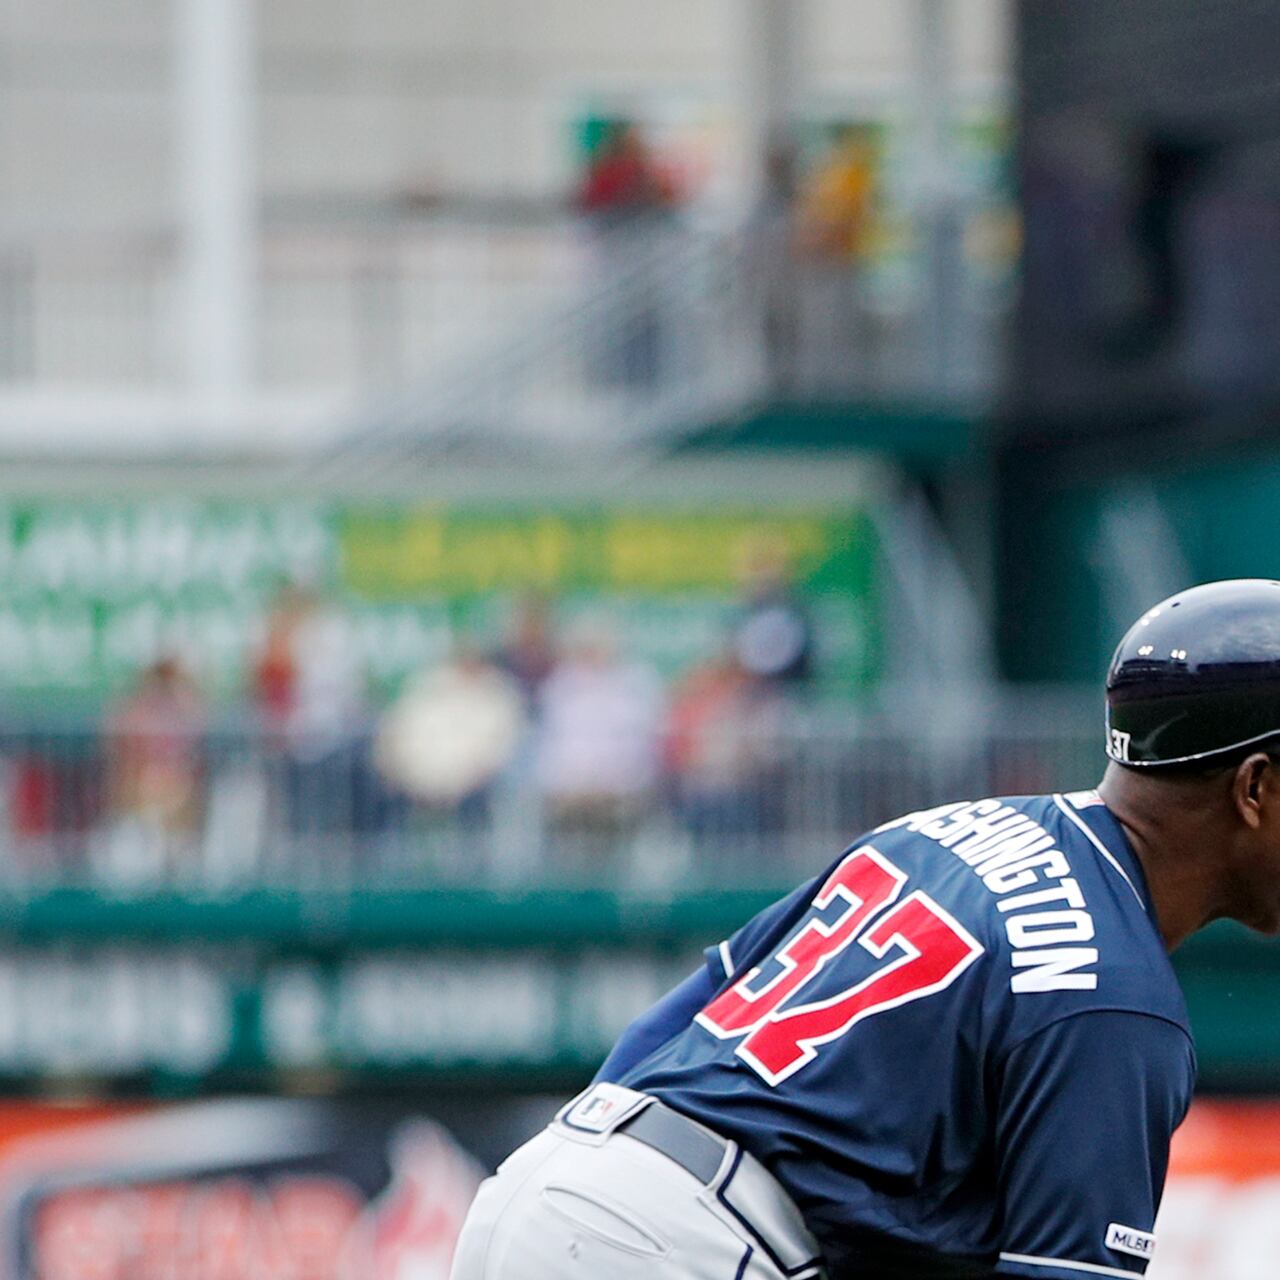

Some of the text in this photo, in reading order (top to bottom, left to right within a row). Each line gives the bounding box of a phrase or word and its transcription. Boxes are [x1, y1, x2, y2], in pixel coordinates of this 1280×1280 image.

[1110, 728, 1131, 761] 37
[694, 844, 985, 1087] 37
[872, 799, 1099, 994] ASHINGTON
